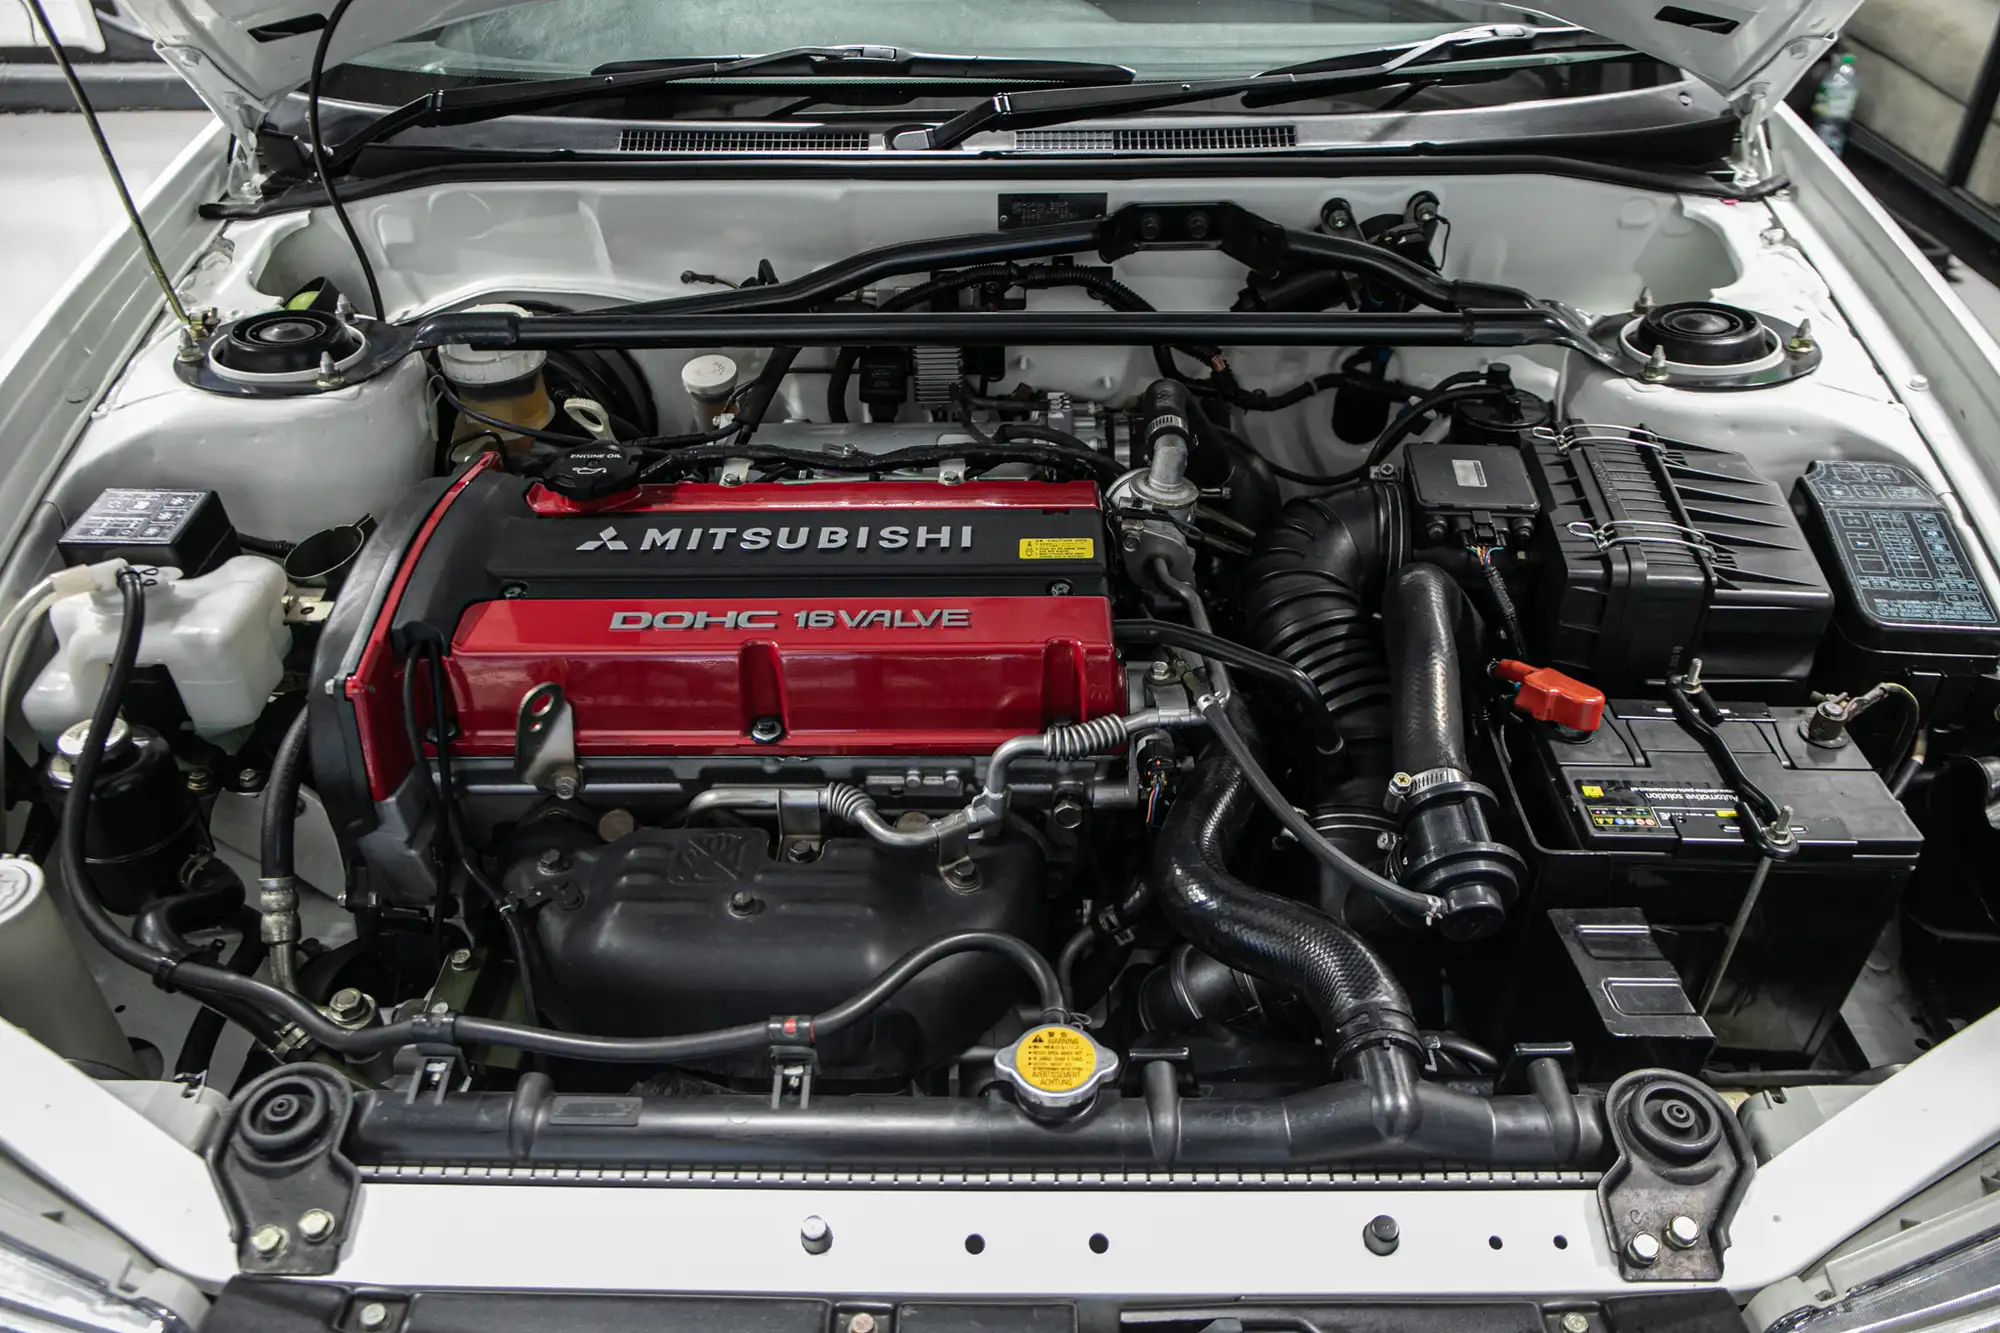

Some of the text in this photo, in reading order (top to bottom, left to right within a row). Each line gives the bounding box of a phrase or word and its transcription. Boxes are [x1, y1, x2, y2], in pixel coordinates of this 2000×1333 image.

[640, 525, 972, 550] MITSUBISHI
[609, 610, 780, 631] DOHC
[1645, 793, 1739, 802] Automotive solution
